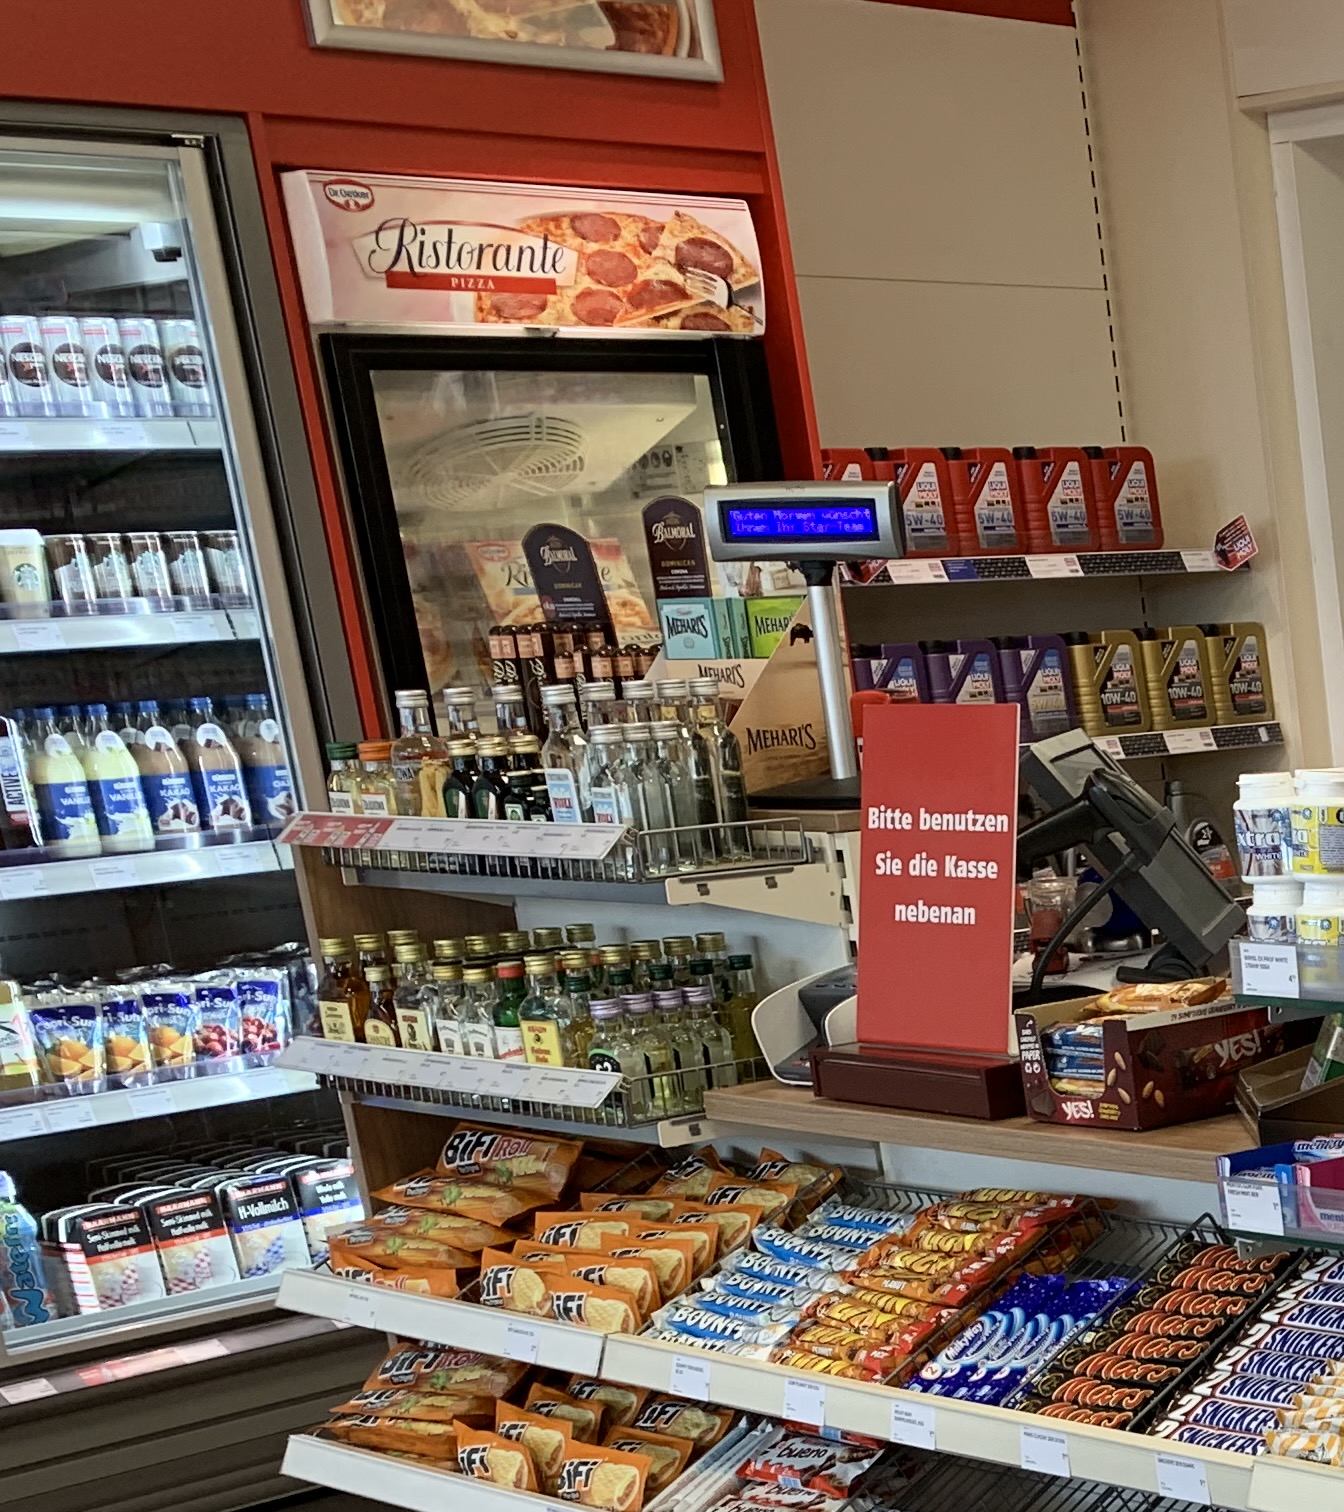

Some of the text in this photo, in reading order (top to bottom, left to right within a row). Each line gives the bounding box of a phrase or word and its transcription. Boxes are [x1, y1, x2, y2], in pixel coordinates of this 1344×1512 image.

[368, 217, 566, 277] Ristorante
[451, 277, 495, 290] PIZZA
[978, 511, 1014, 526] 5W-40
[1051, 510, 1086, 525] 5W-40
[652, 522, 696, 543] BALMORAL
[665, 615, 708, 640] MEHARI'S
[698, 664, 745, 689] MEHARI'S
[1100, 692, 1136, 705] 10W-40
[746, 724, 817, 756] MEHARI'S
[160, 787, 190, 797] KAKAO
[867, 806, 1009, 832] Bitte benutzen
[875, 853, 999, 879] Sie die Kasse
[1255, 852, 1280, 861] WHITE
[894, 902, 976, 925] nebenan
[1214, 1030, 1263, 1063] YES!
[1061, 1100, 1094, 1121] YES!
[238, 1198, 289, 1219] H-Vollmilch
